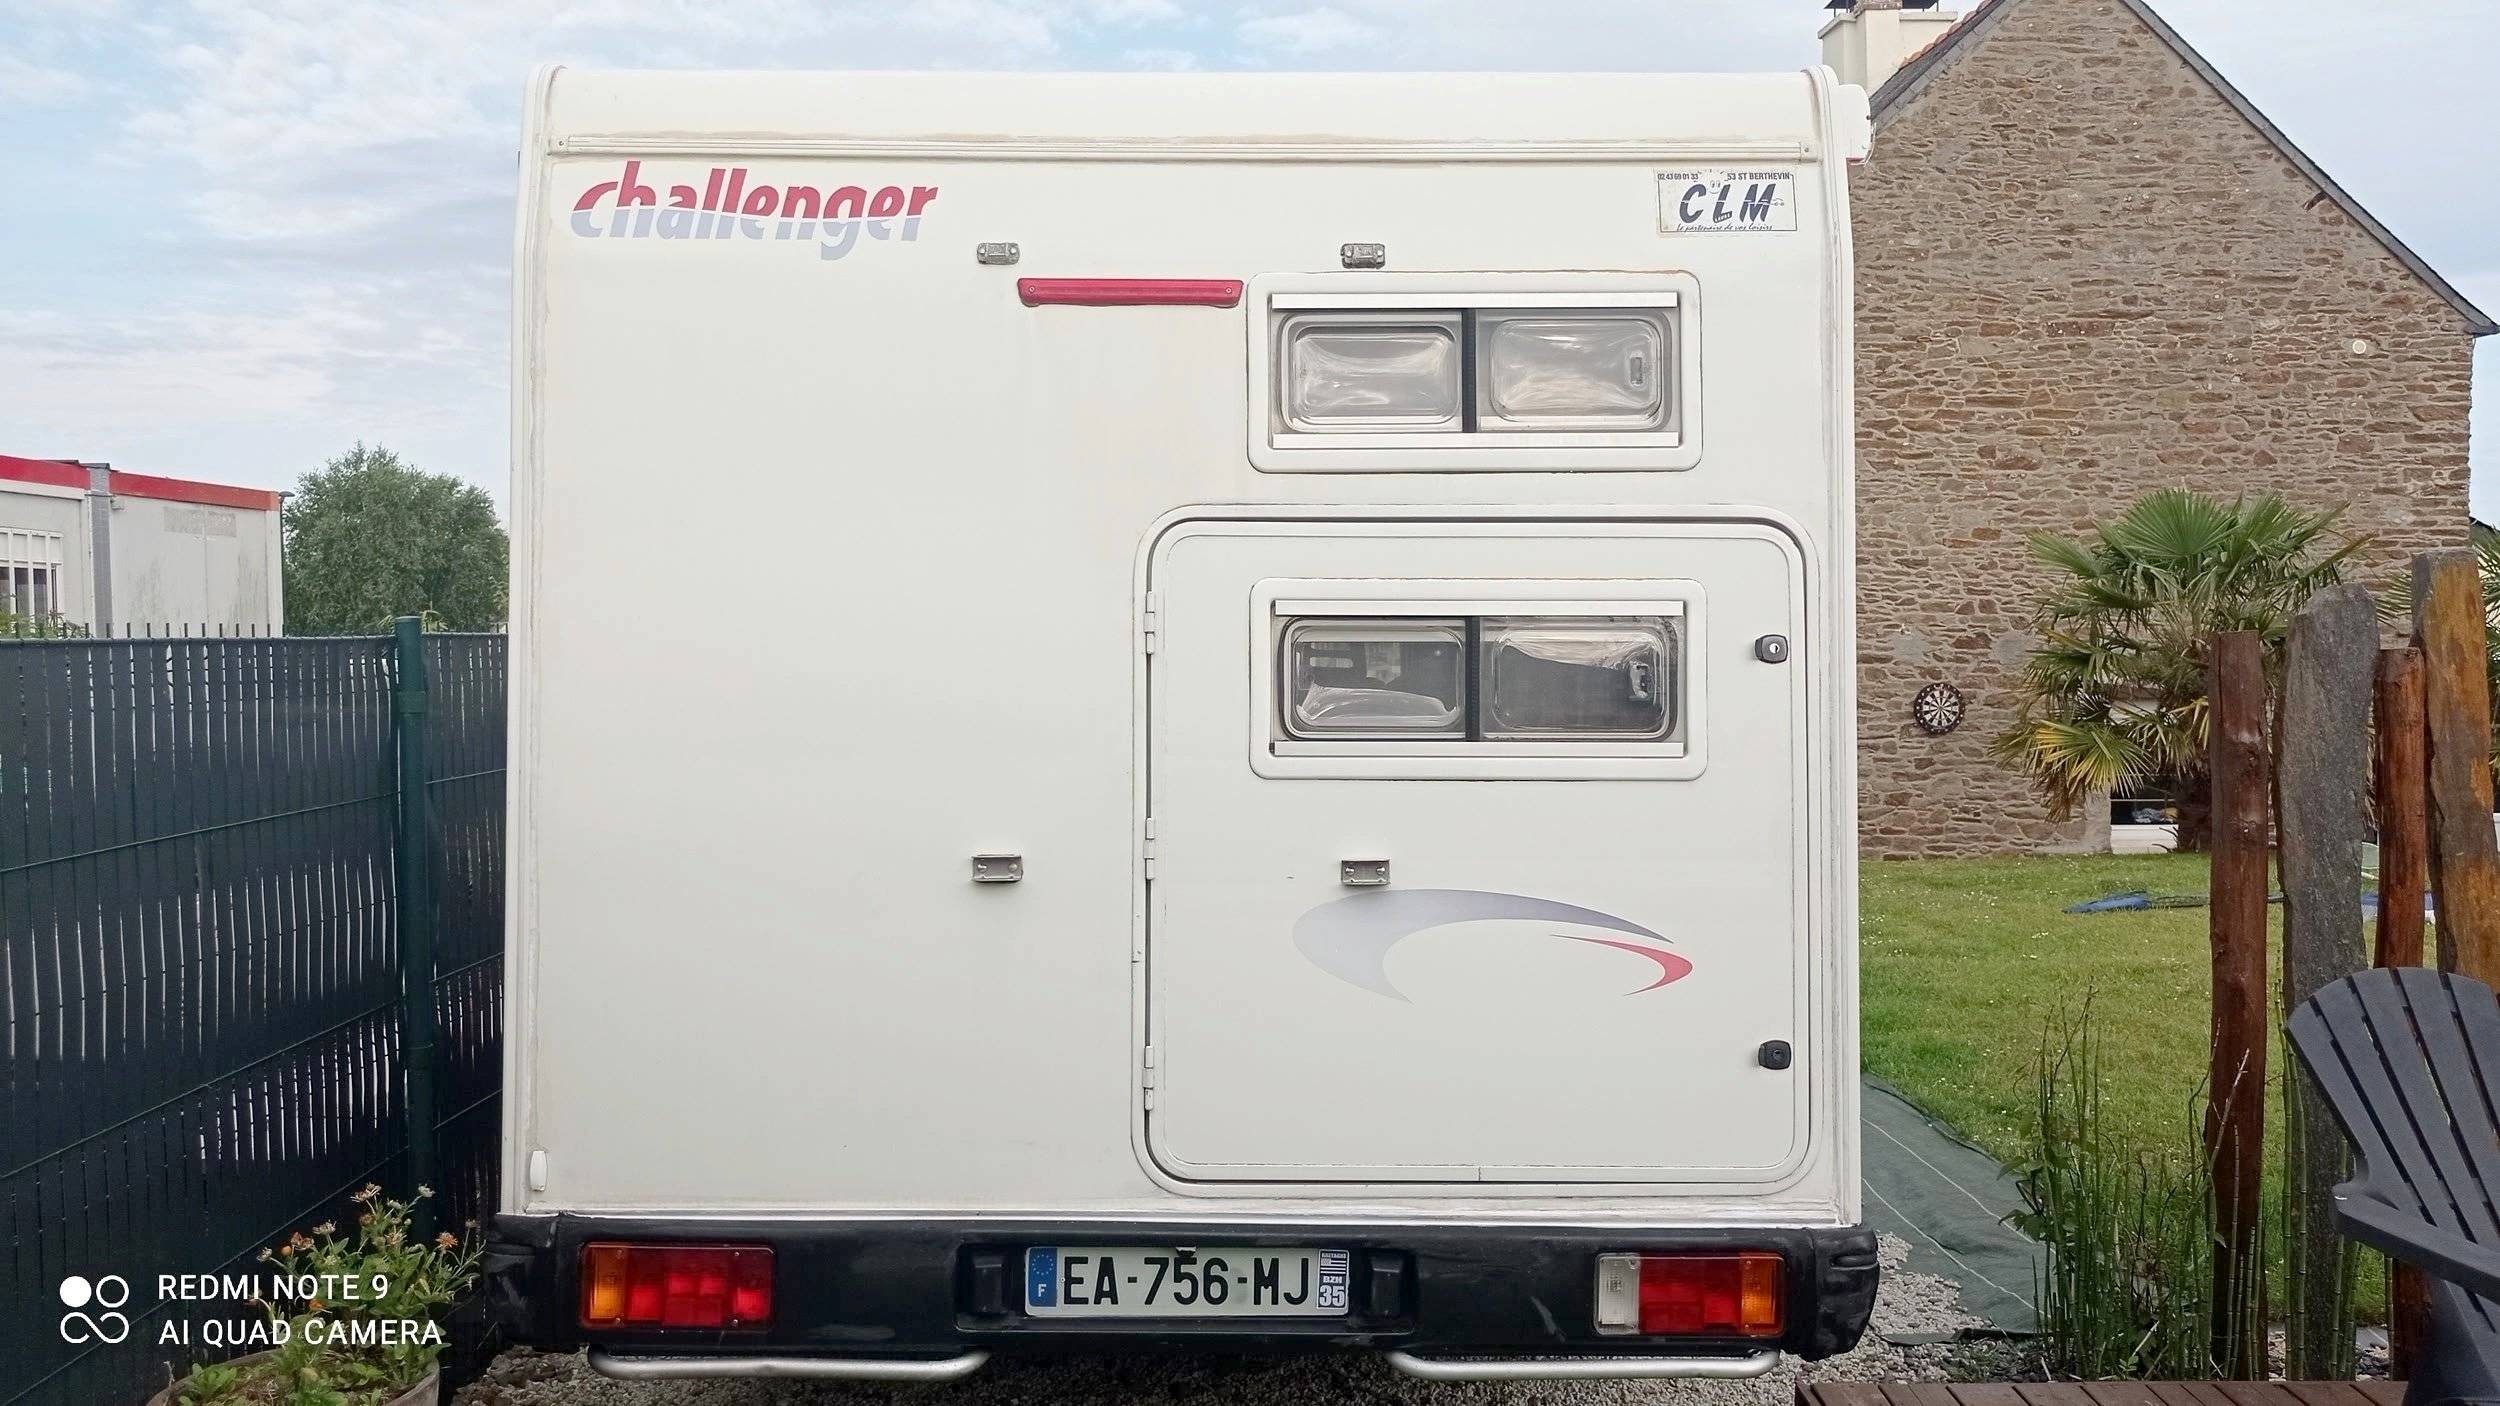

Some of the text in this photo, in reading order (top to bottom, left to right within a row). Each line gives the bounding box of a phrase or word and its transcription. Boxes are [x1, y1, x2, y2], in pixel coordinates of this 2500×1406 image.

[1727, 172, 1790, 181] 53 ST BERTHEVIN
[570, 160, 939, 261] challenger
[1679, 183, 1777, 223] CLM
[1063, 1256, 1310, 1306] EA-756-MJ
[1323, 1275, 1343, 1284] BZH
[1037, 1283, 1047, 1298] F
[1319, 1285, 1346, 1306] 35
